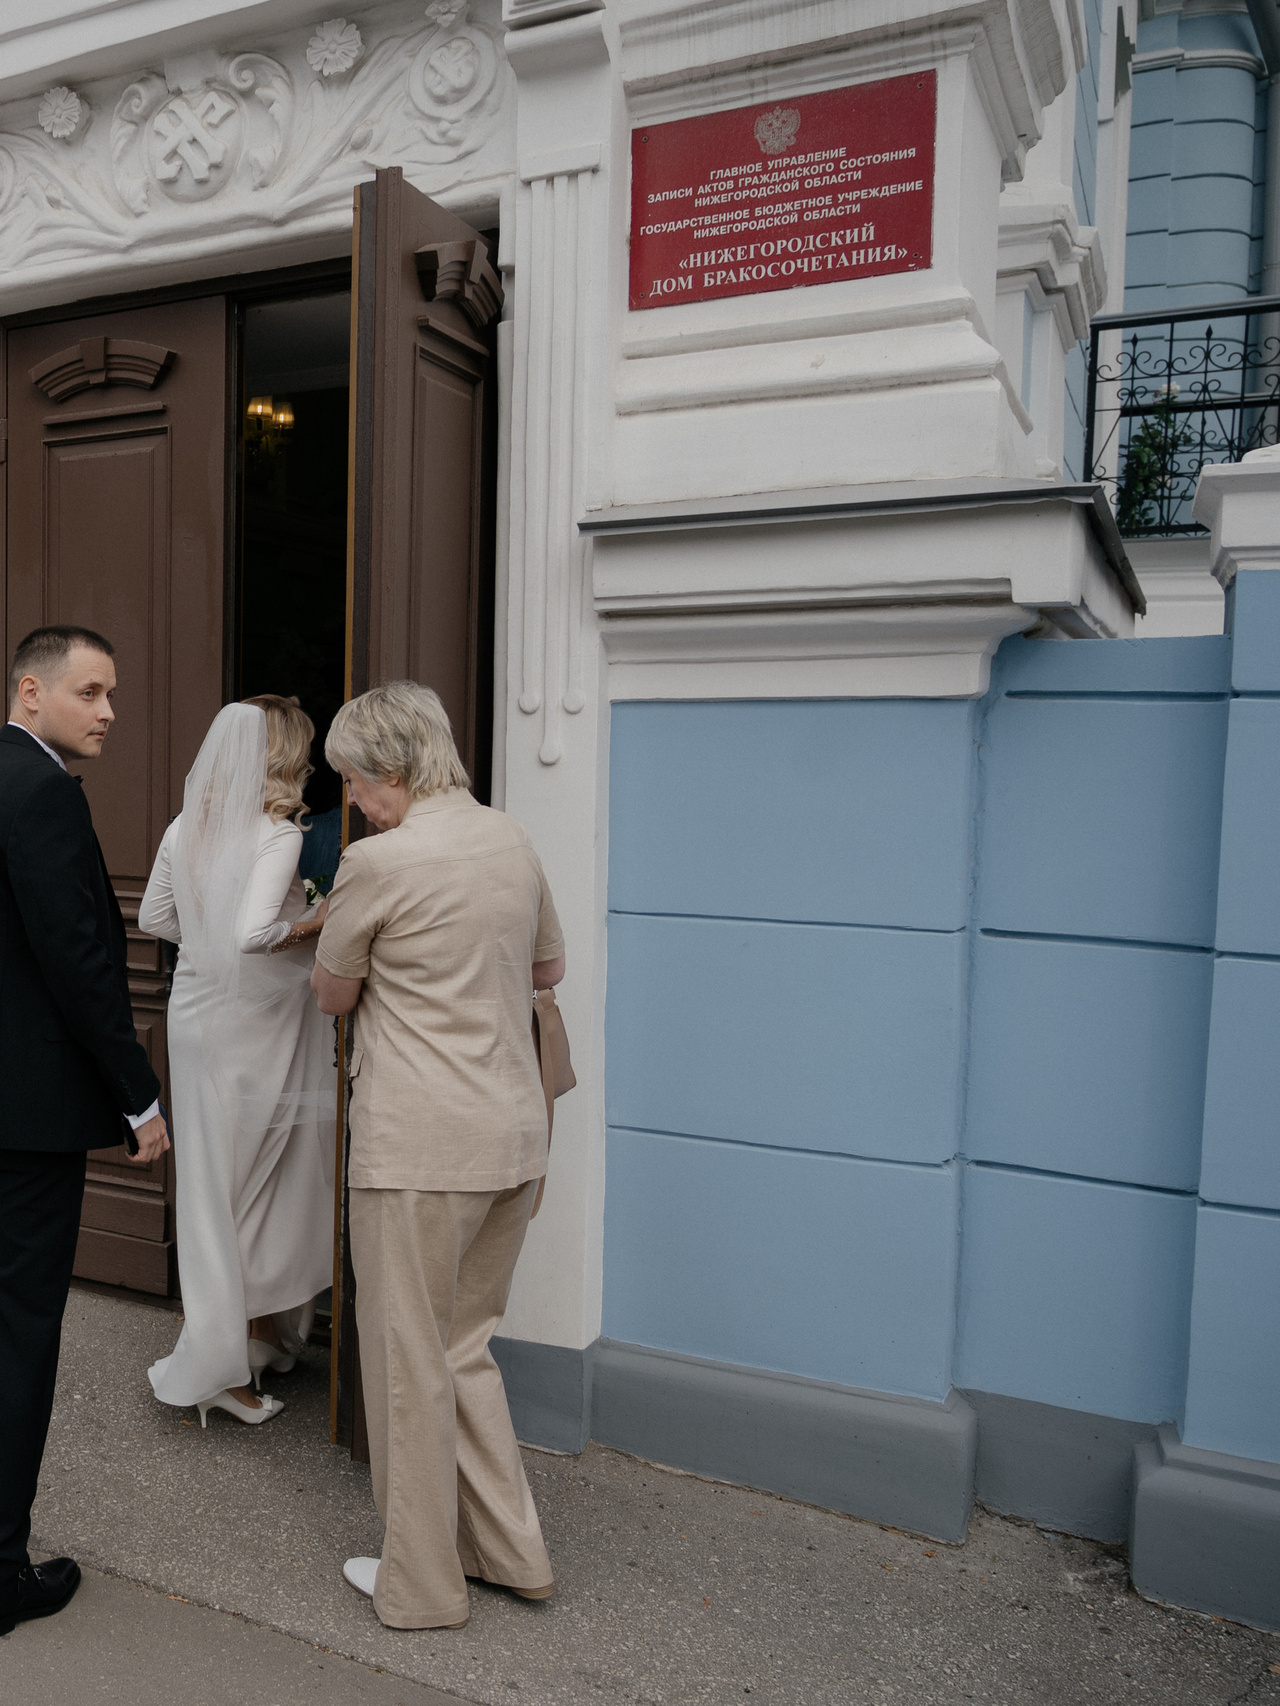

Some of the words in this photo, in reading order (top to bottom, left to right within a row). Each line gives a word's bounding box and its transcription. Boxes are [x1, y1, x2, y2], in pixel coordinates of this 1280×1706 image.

[647, 187, 693, 203] ЗАПИСИ
[698, 180, 734, 195] АКТОВ
[739, 162, 834, 188] ГРАЖДАНСКОГО
[839, 148, 916, 170] СОСТОЯНИЯ
[710, 162, 762, 180] ГЛАВНОЕ
[768, 147, 846, 171] УПРАВЛЕНИЕ
[640, 209, 750, 235] ГОСУДАРСТВЕННОЕ
[755, 195, 833, 217] БЮДЖЕТНОЕ
[838, 180, 923, 203] УЧРЕЖДЕНИЕ
[695, 179, 799, 207] НИЖЕГОРОДСКОЙ
[804, 170, 862, 188] ОБЛАСТИ
[694, 213, 799, 239] НИЖЕГОРОДСКОЙ
[804, 203, 860, 221] ОБЛАСТИ
[678, 223, 876, 270] «НИЖЕГОРОДСКИЙ
[650, 275, 693, 297] ДОМ
[703, 245, 908, 287] БРАКОСОЧЕТАНИЯ»
